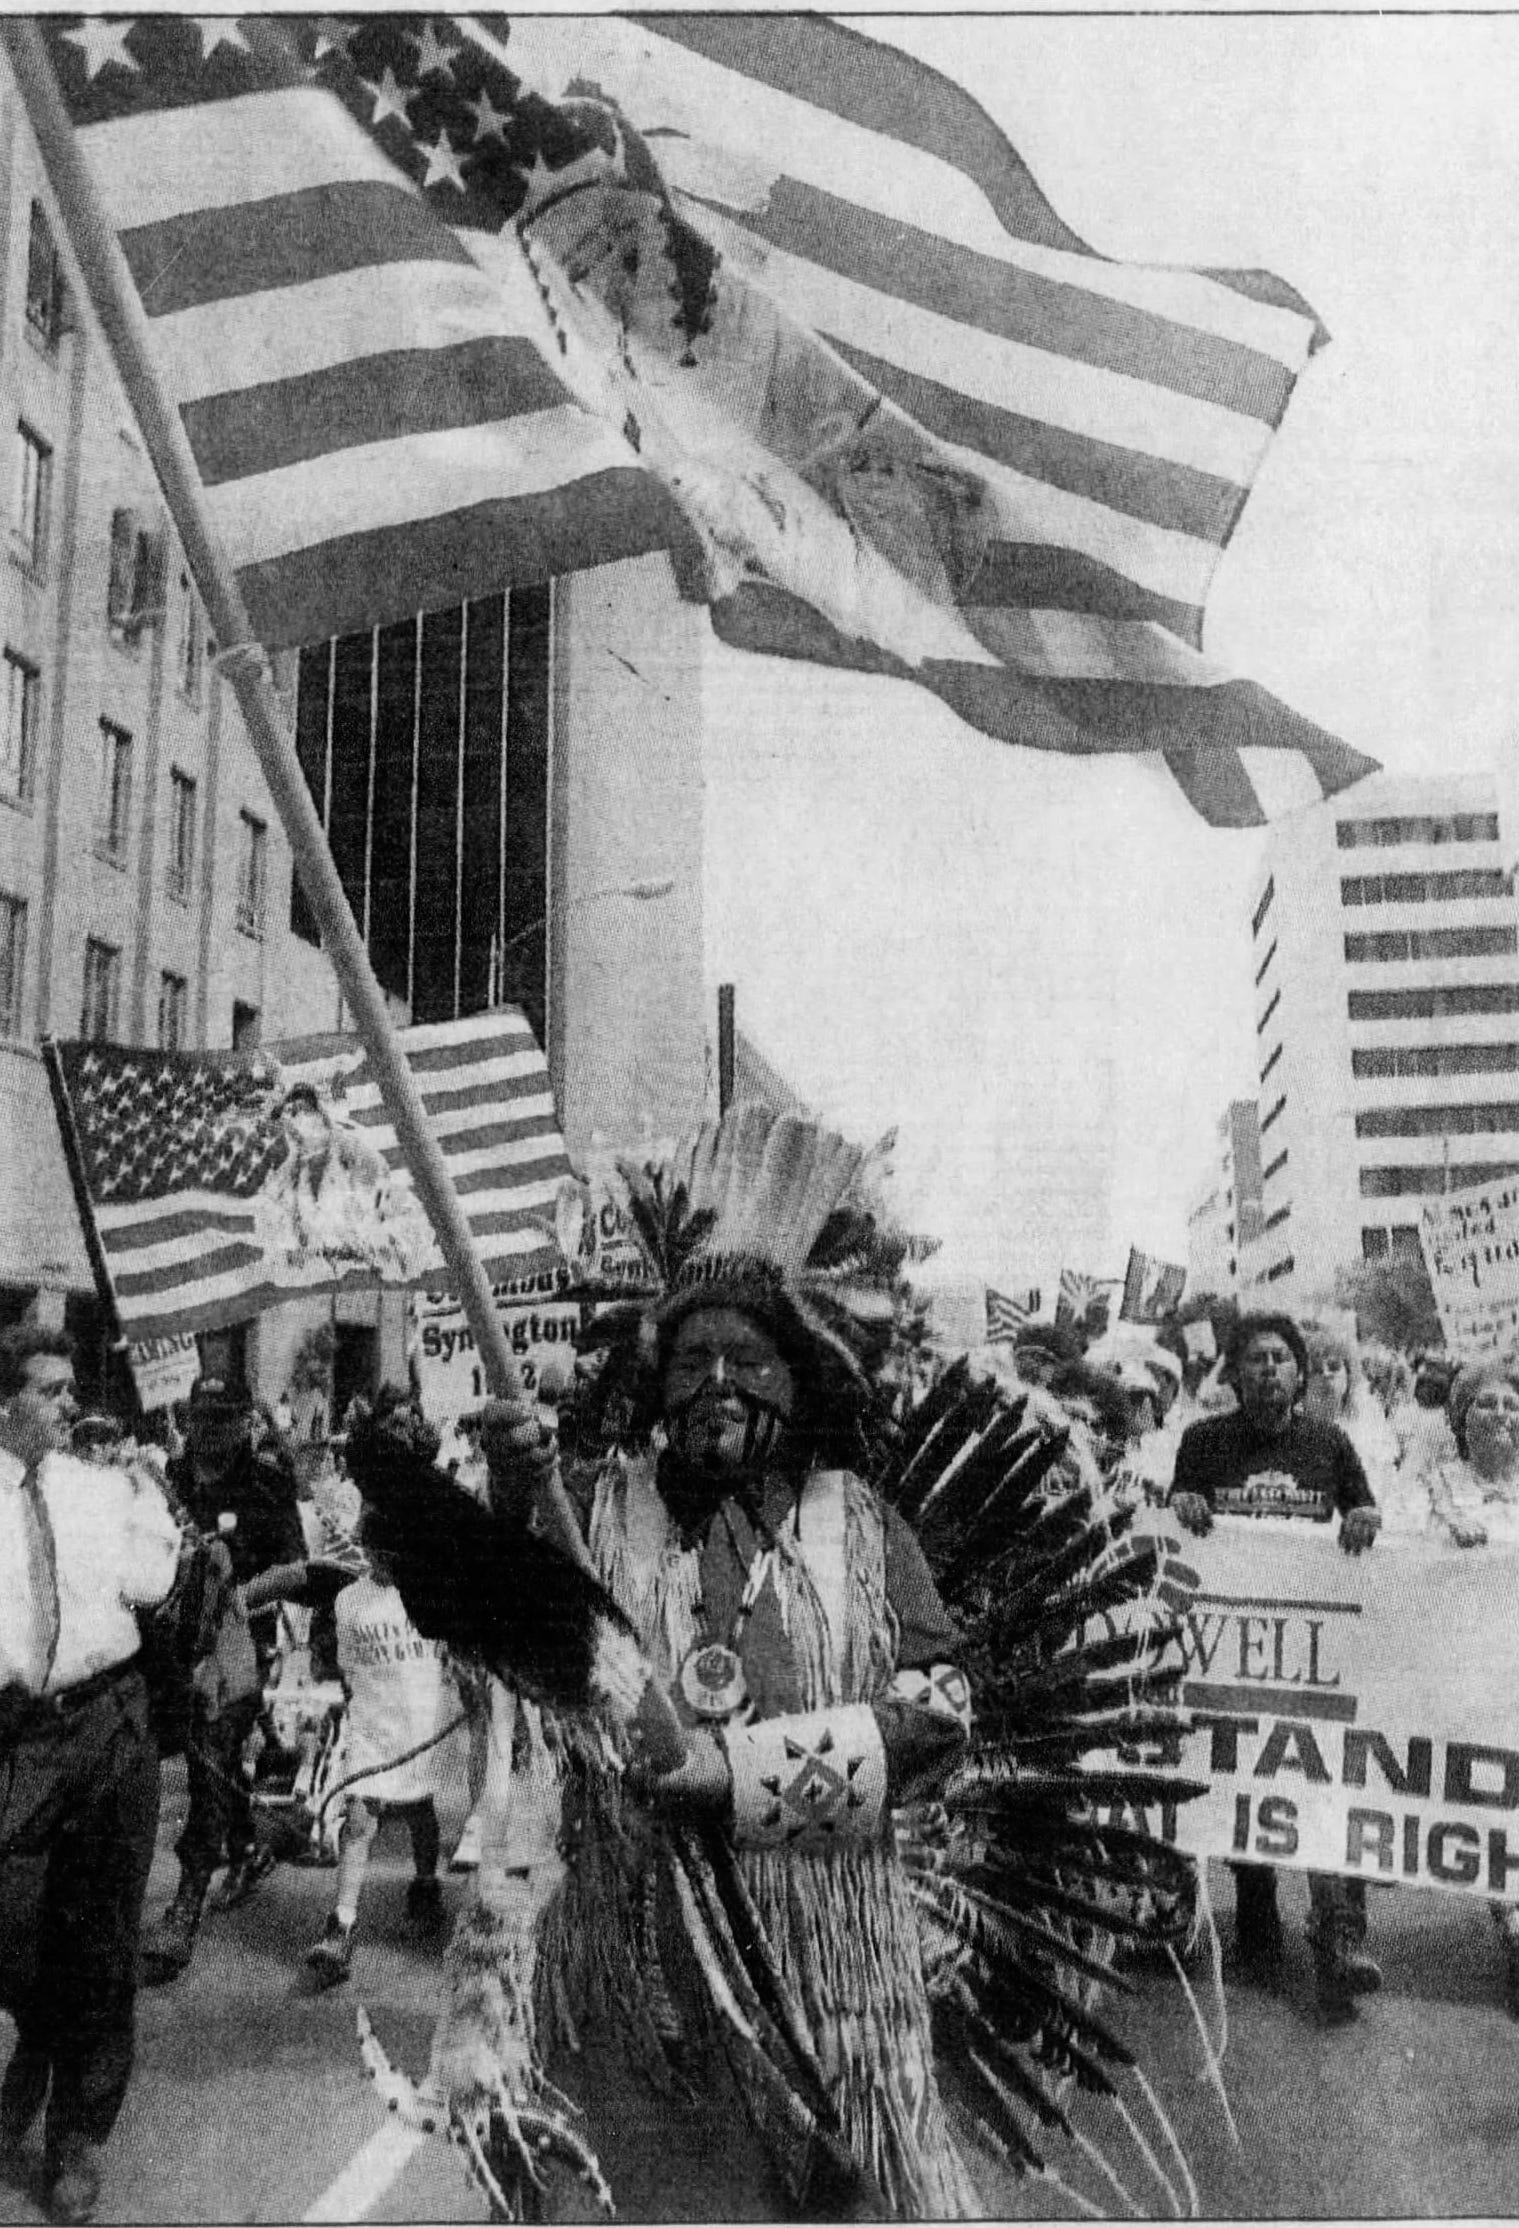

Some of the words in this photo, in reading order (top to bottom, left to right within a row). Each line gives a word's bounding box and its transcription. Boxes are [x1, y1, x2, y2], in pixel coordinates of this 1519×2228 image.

[422, 1312, 578, 1363] Sygton
[1150, 1608, 1340, 1687] WELL
[1232, 1793, 1299, 1855] IS
